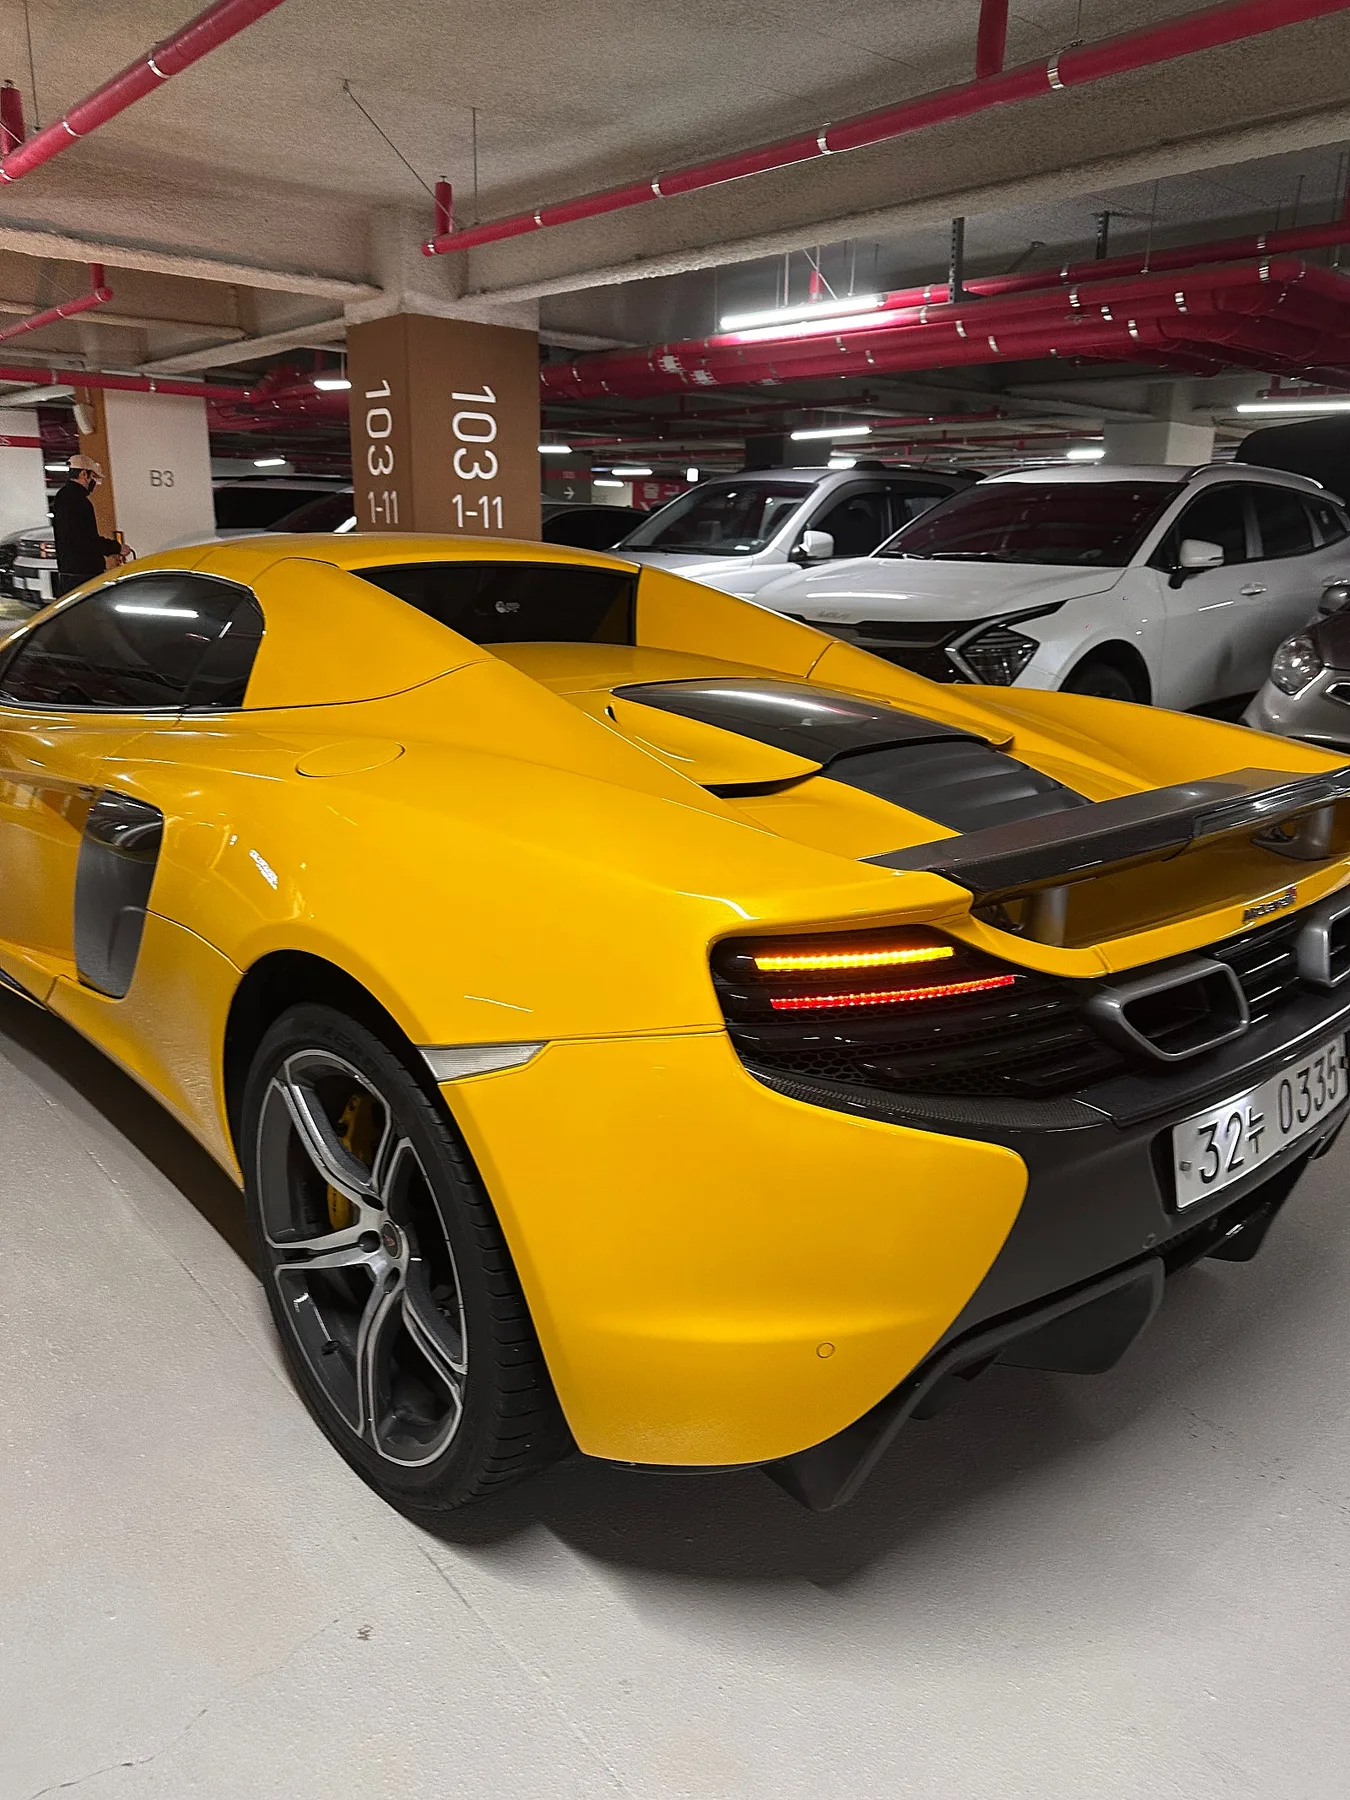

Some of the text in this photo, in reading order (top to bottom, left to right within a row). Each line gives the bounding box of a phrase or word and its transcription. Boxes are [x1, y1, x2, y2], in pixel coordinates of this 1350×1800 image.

[365, 379, 394, 476] 103
[451, 385, 499, 480] 103
[150, 469, 175, 488] B3
[367, 490, 399, 525] 1-11
[452, 494, 503, 529] 1-11
[1197, 1046, 1339, 1184] 32누 0335
